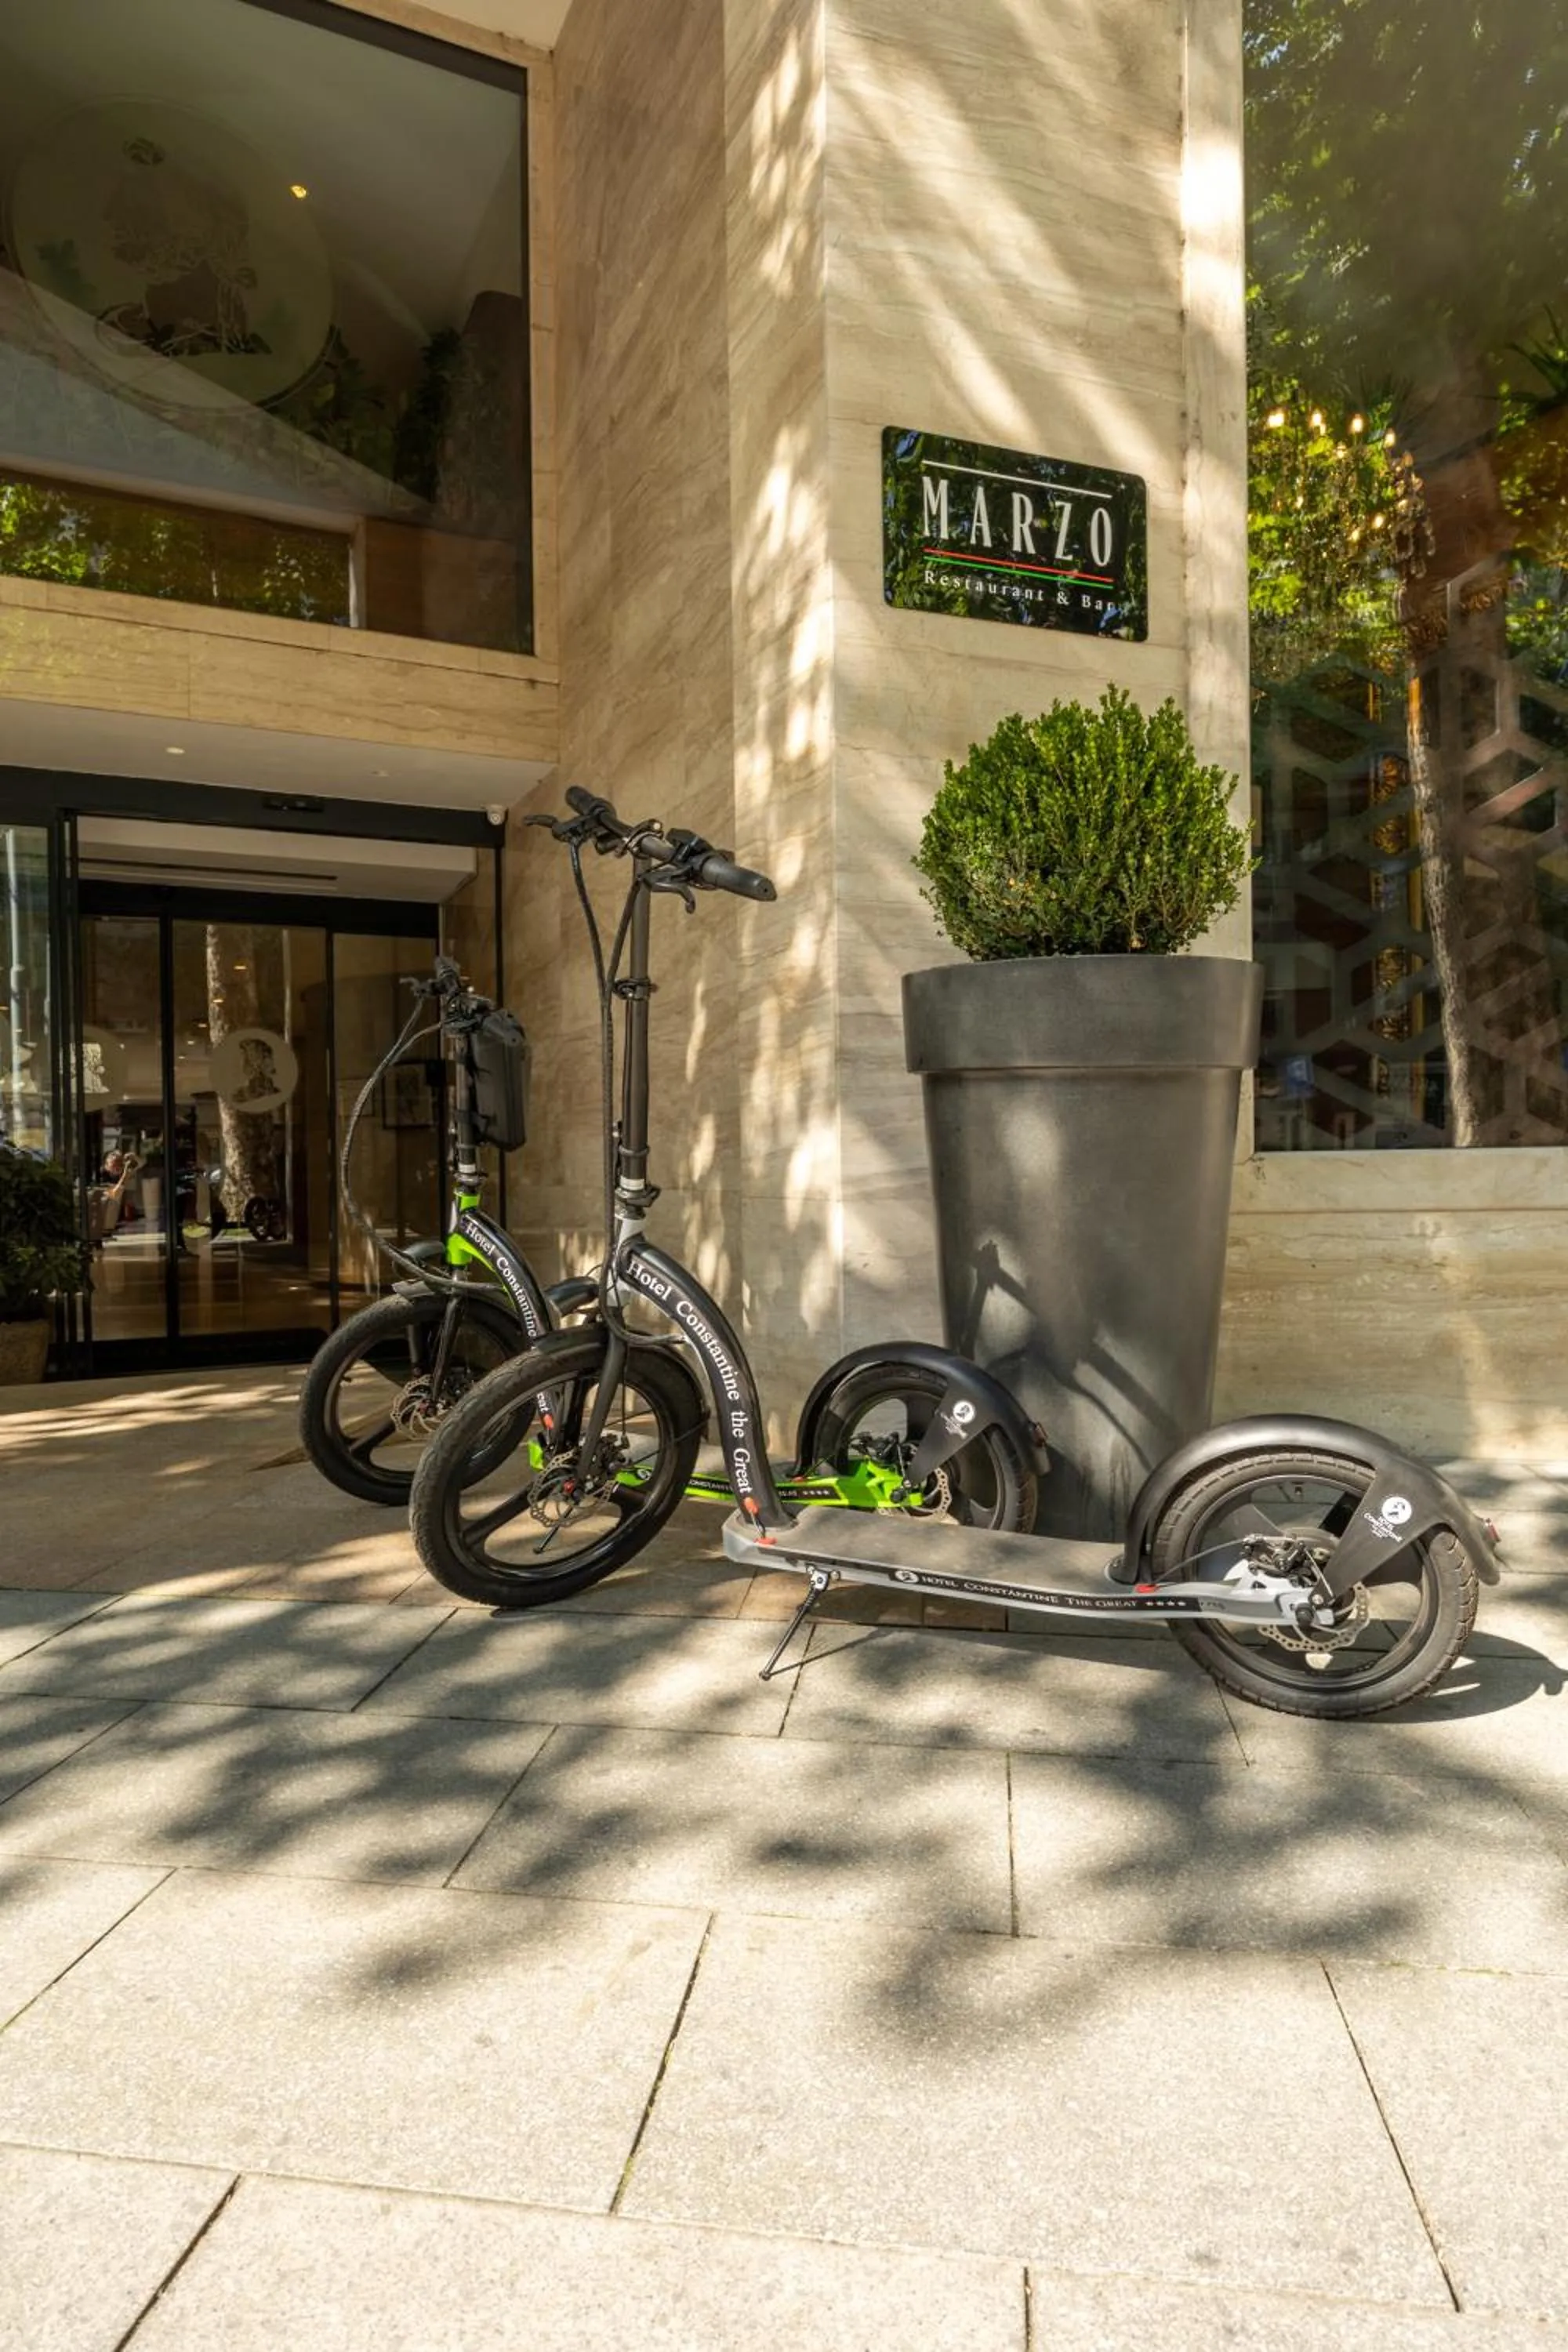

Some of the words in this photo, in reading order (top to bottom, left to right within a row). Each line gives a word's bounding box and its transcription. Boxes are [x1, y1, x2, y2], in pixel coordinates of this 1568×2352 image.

[921, 476, 1112, 568] MARZO
[924, 570, 1044, 602] Restaurant
[1057, 592, 1069, 606] &
[1081, 593, 1114, 612] Bar
[464, 1222, 496, 1256] Hotel
[496, 1257, 538, 1338] Constantine
[626, 1260, 673, 1301] Hotel
[676, 1301, 740, 1401] Constantine
[730, 1410, 749, 1438] the
[733, 1448, 753, 1494] Great
[921, 1576, 959, 1588] HOTEL
